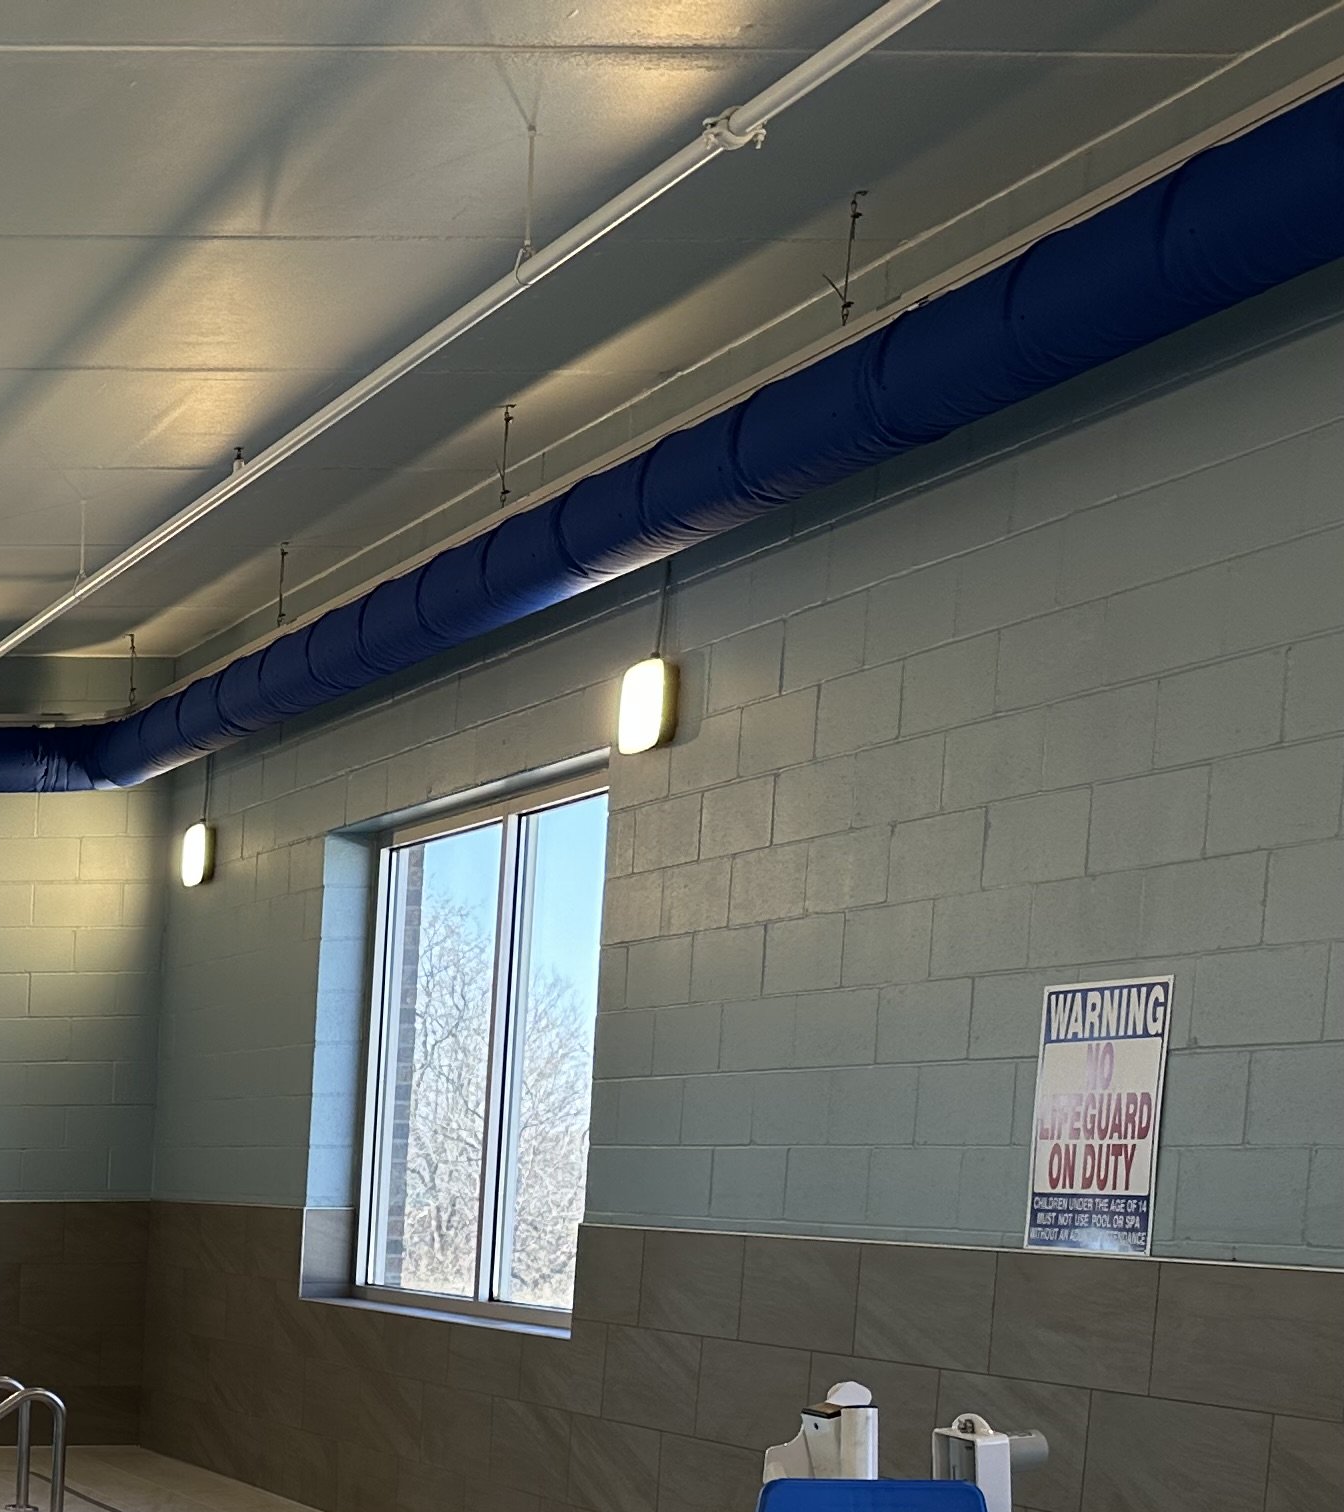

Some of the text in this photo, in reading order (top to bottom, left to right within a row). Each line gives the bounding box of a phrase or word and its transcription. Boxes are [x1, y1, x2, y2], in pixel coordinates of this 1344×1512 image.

[1050, 985, 1165, 1040] WARNING
[1087, 1042, 1115, 1090] NO
[1038, 1092, 1153, 1141] LIFEGUARD
[1048, 1143, 1136, 1191] ON DUTY
[1033, 1197, 1146, 1213] CHILDREN UNDER THE AGE OF 14
[1037, 1212, 1140, 1229] MUST NOT USE POOL OR SPA
[1030, 1227, 1059, 1240] WITHOUT
[1059, 1228, 1069, 1241] AN
